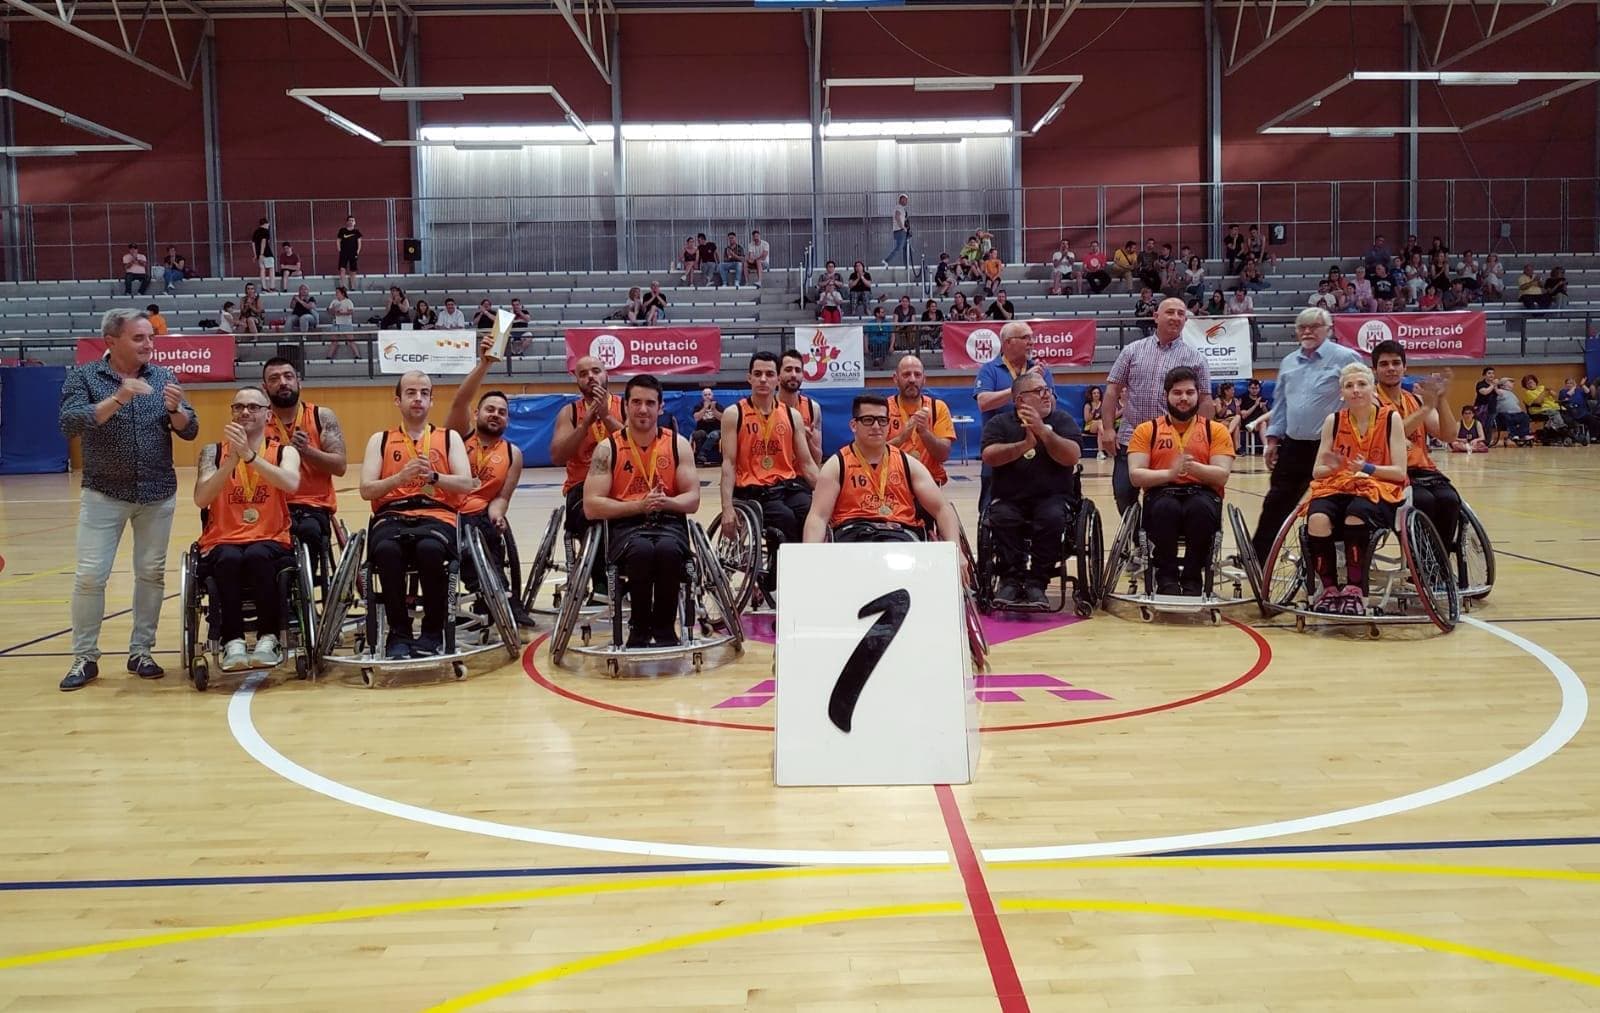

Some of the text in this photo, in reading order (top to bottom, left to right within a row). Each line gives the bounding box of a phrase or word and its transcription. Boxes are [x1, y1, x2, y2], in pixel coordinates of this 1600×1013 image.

[1397, 324, 1464, 338] Diputació
[1030, 332, 1073, 344] utació
[630, 340, 698, 353] Diputació
[1399, 339, 1463, 350] Barcelona
[395, 354, 429, 362] FCEDF
[1031, 347, 1073, 358] celona
[631, 354, 698, 365] Barcelona
[746, 423, 758, 435] 10
[1159, 439, 1173, 449] 20
[393, 450, 402, 462] 6
[624, 460, 634, 473] 4
[851, 474, 867, 488] 16
[828, 588, 911, 733] 1
